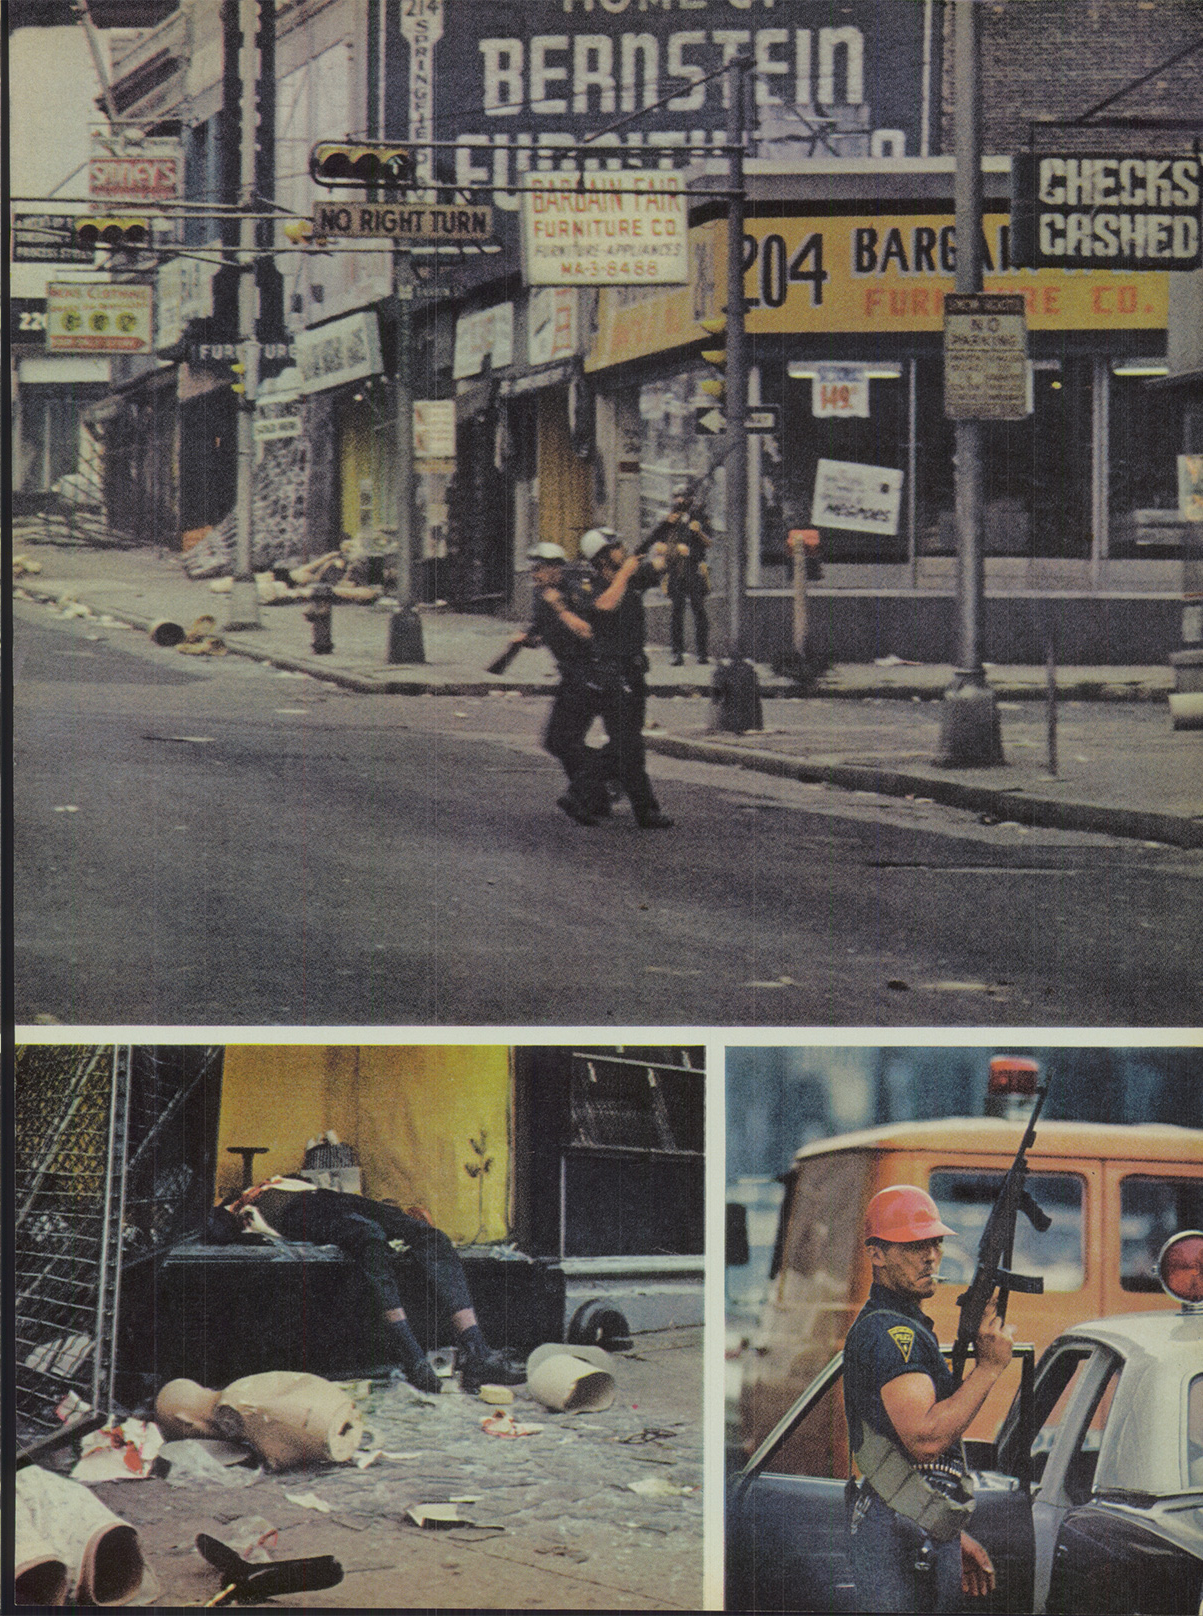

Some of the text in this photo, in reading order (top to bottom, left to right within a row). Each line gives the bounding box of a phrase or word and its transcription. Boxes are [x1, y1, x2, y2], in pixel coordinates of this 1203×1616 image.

[479, 27, 864, 116] BERNSTEIN
[531, 177, 681, 213] BARGAIN FAIR
[1039, 158, 1200, 207] CHECKS
[320, 206, 487, 235] NO RIGHT TURN
[534, 219, 643, 238] FURNITURE
[1039, 213, 1199, 259] CASHED
[1091, 286, 1155, 315] CO.
[970, 317, 1000, 334] NO
